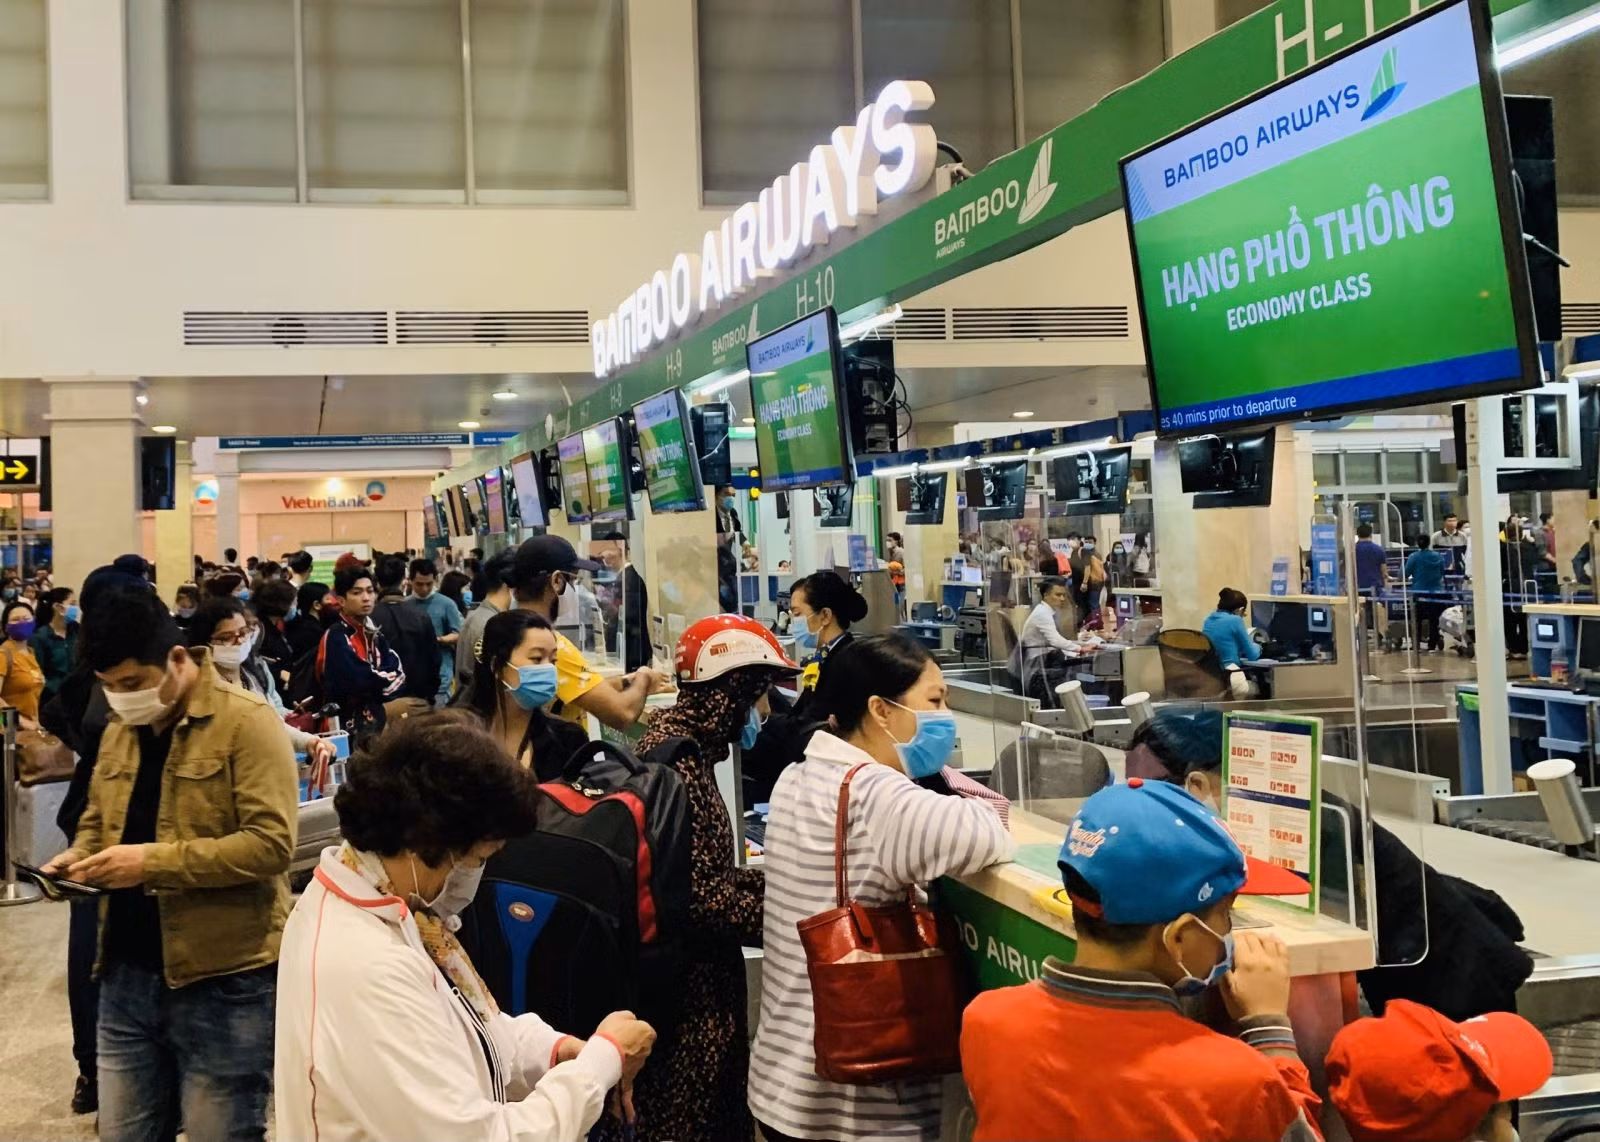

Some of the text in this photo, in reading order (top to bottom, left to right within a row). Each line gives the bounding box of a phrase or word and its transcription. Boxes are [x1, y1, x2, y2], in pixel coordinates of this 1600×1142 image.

[1164, 84, 1360, 188] BAMBOO AIRWAYS
[592, 80, 930, 378] BAMBOO AIRWAYS
[935, 180, 1019, 245] BAMBOO
[936, 238, 966, 258] AIRWAYS
[1162, 176, 1455, 312] HẠNG PHỔ THÔNG
[796, 265, 834, 320] H-10
[1227, 272, 1372, 331] ECONOMY CLASS
[666, 348, 682, 382] H-9
[712, 324, 746, 356] BAMBOO
[1172, 412, 1183, 426] 40
[1185, 409, 1207, 424] mins
[1209, 405, 1231, 423] prior
[1233, 404, 1243, 416] to
[1246, 396, 1297, 416] departure
[281, 495, 367, 509] VietinBank
